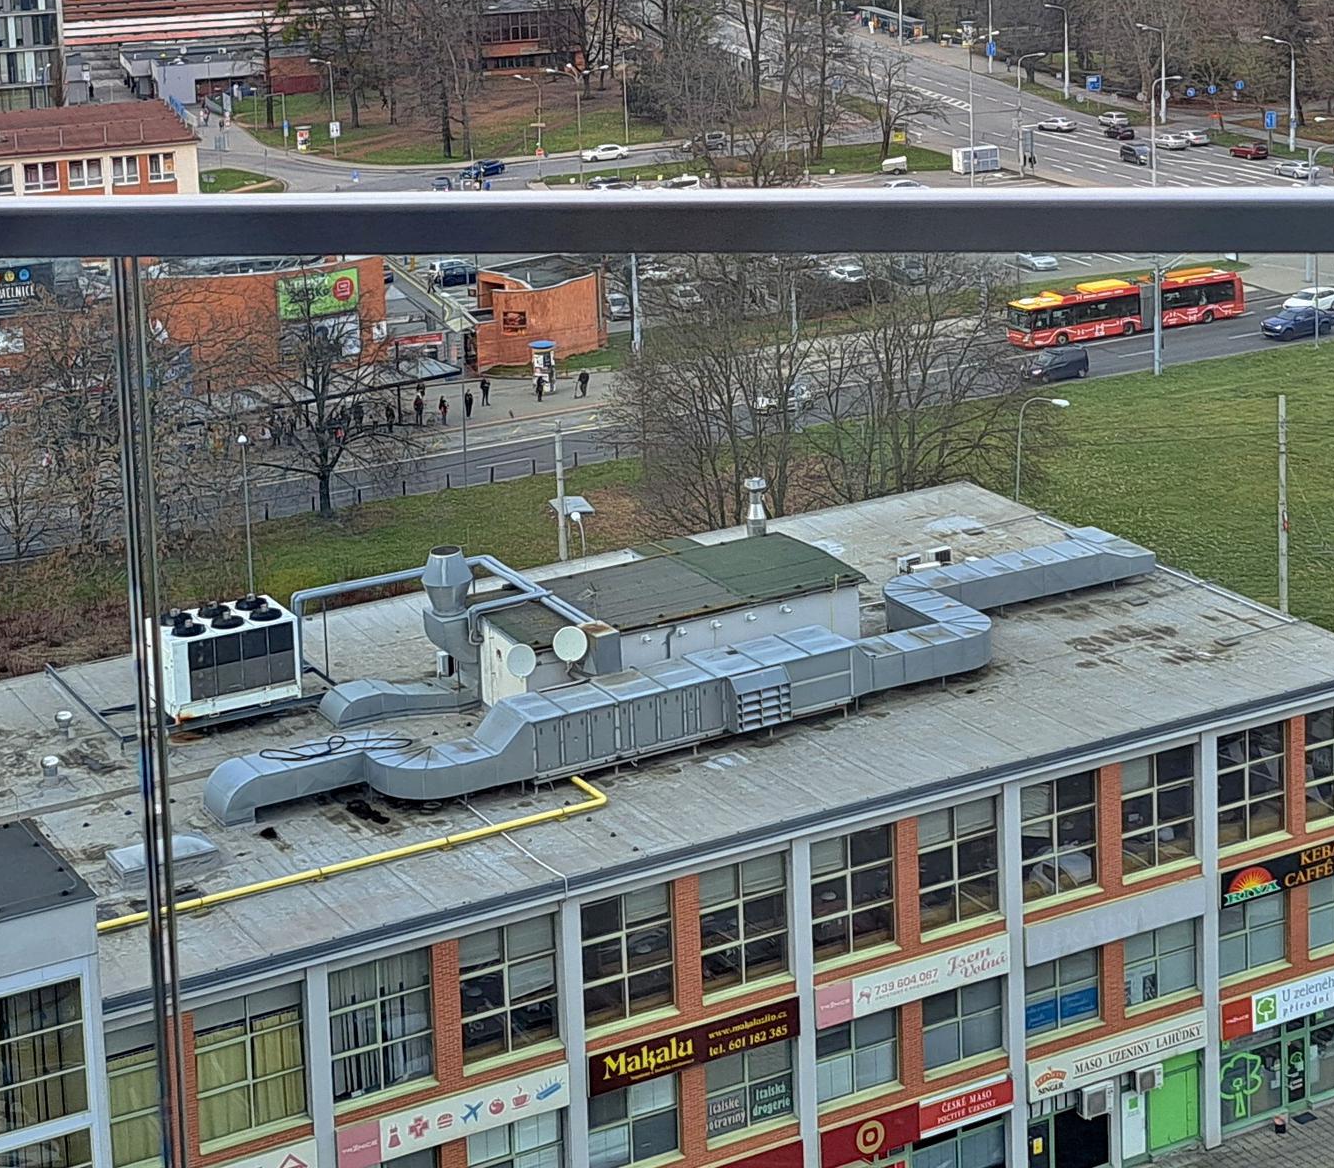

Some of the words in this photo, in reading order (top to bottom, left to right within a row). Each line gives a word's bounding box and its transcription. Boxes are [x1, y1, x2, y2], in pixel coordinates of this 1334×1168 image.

[946, 945, 993, 976] Jsem
[960, 951, 1008, 980] Volná
[874, 981, 895, 996] 739
[1282, 989, 1291, 1002] U
[1282, 994, 1330, 1017] přírodní
[709, 1043, 726, 1057] tel.
[728, 1036, 746, 1051] 601
[749, 1030, 767, 1045] 182
[768, 1024, 788, 1039] 385
[1074, 1057, 1103, 1075] MASO
[1108, 1041, 1151, 1064] UZENINY
[1156, 1024, 1203, 1049] LAHŮDKY
[602, 1037, 696, 1081] Makalu
[755, 1081, 787, 1101] Italská
[941, 1093, 967, 1114] ČESKÉ
[969, 1089, 993, 1104] MASO
[752, 1093, 791, 1117] drogerie
[937, 1108, 966, 1125] POCTIVÉ
[968, 1099, 997, 1115] UZENINY
